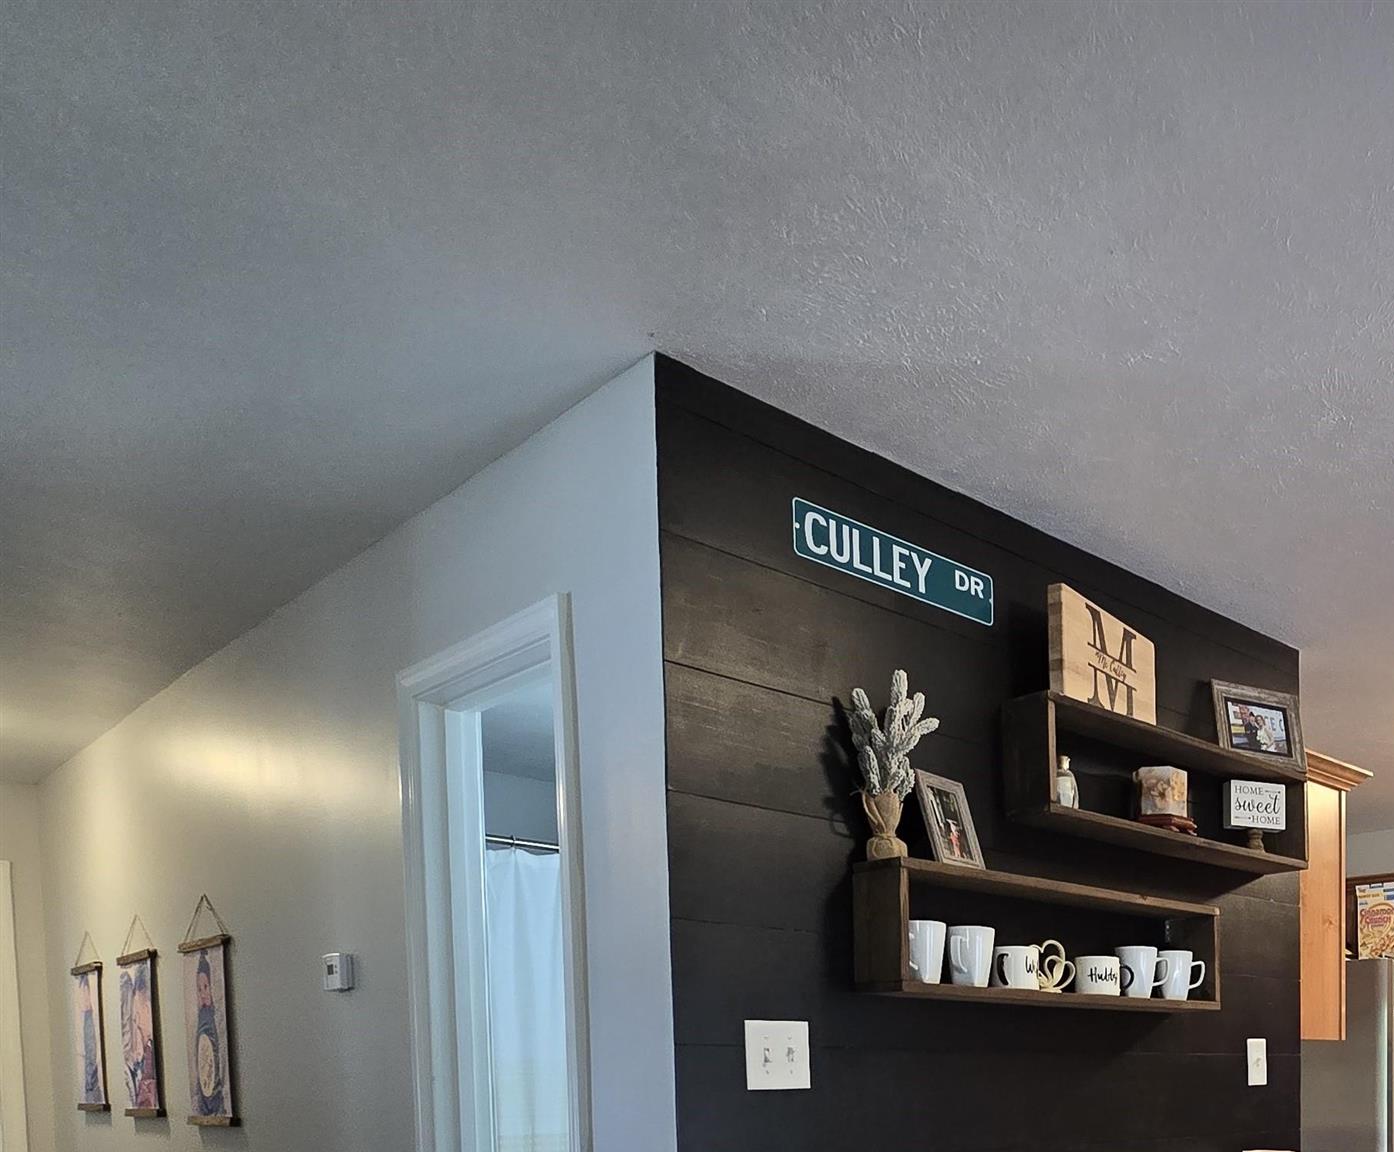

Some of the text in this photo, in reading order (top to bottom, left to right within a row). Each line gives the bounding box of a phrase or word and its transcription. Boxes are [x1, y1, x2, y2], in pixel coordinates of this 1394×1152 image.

[804, 511, 984, 599] CULLEY DR
[1234, 785, 1264, 796] HOME
[1234, 794, 1281, 815] sweet
[1251, 815, 1281, 825] HOME
